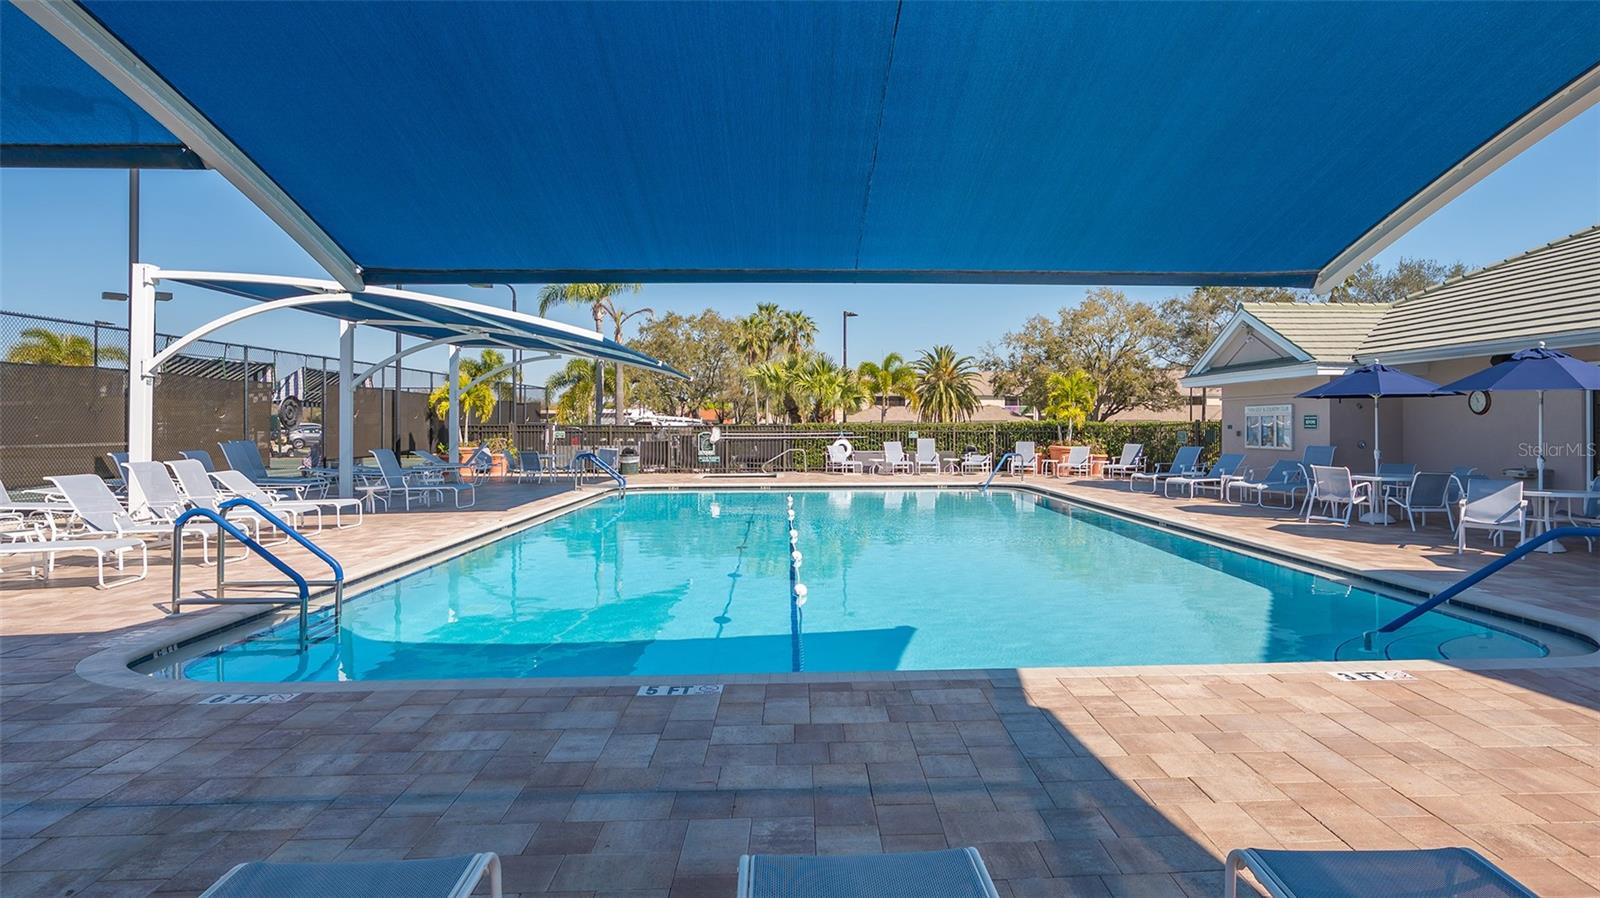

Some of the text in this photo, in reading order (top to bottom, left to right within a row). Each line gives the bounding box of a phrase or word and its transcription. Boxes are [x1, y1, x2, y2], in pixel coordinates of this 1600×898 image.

[1337, 672, 1385, 681] 3 FT
[645, 686, 693, 695] 5 FT
[208, 694, 269, 704] 6 FT
